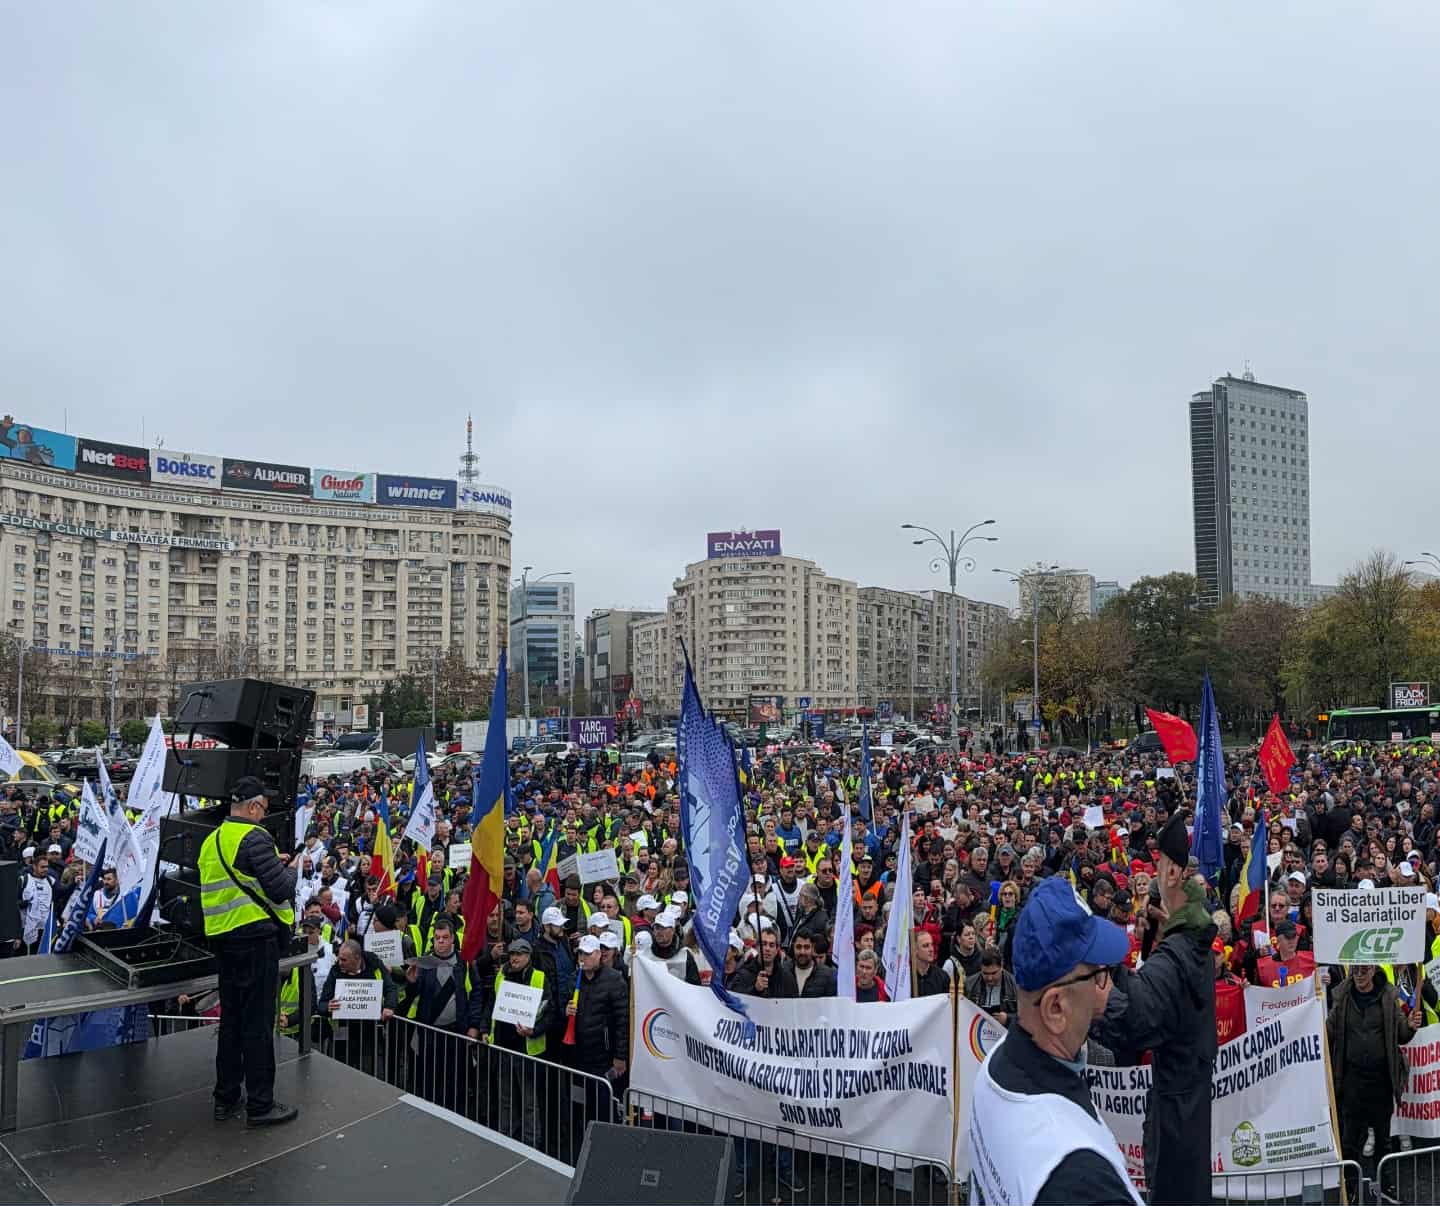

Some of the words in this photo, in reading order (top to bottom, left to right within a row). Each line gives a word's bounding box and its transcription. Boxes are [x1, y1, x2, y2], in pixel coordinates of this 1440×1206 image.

[82, 449, 146, 470] NetBet
[156, 457, 216, 479] BORSEC
[254, 467, 306, 485] ALBACHER
[321, 474, 364, 491] Giusto
[387, 482, 445, 500] winner
[56, 523, 105, 538] CLINIC
[714, 540, 774, 551] ENAYATI
[1395, 689, 1424, 698] BLACK
[1316, 891, 1384, 907] Sindicatul
[1389, 890, 1425, 905] Liber
[1326, 910, 1337, 923] al
[1341, 908, 1416, 926] Salariaților
[849, 1028, 870, 1059] DIN
[872, 1028, 912, 1060] CADRUL
[1220, 1042, 1241, 1071] DIN
[1243, 1020, 1285, 1060] CADRUL
[1279, 1035, 1321, 1069] RURALE
[685, 1035, 747, 1083] MINISTERULUI
[748, 1061, 820, 1099] AGRICULTURII
[836, 1061, 905, 1099] DEZVOLTĂRII
[908, 1062, 947, 1096] RURALE
[780, 1101, 806, 1125] SIND
[807, 1105, 843, 1128] MADR
